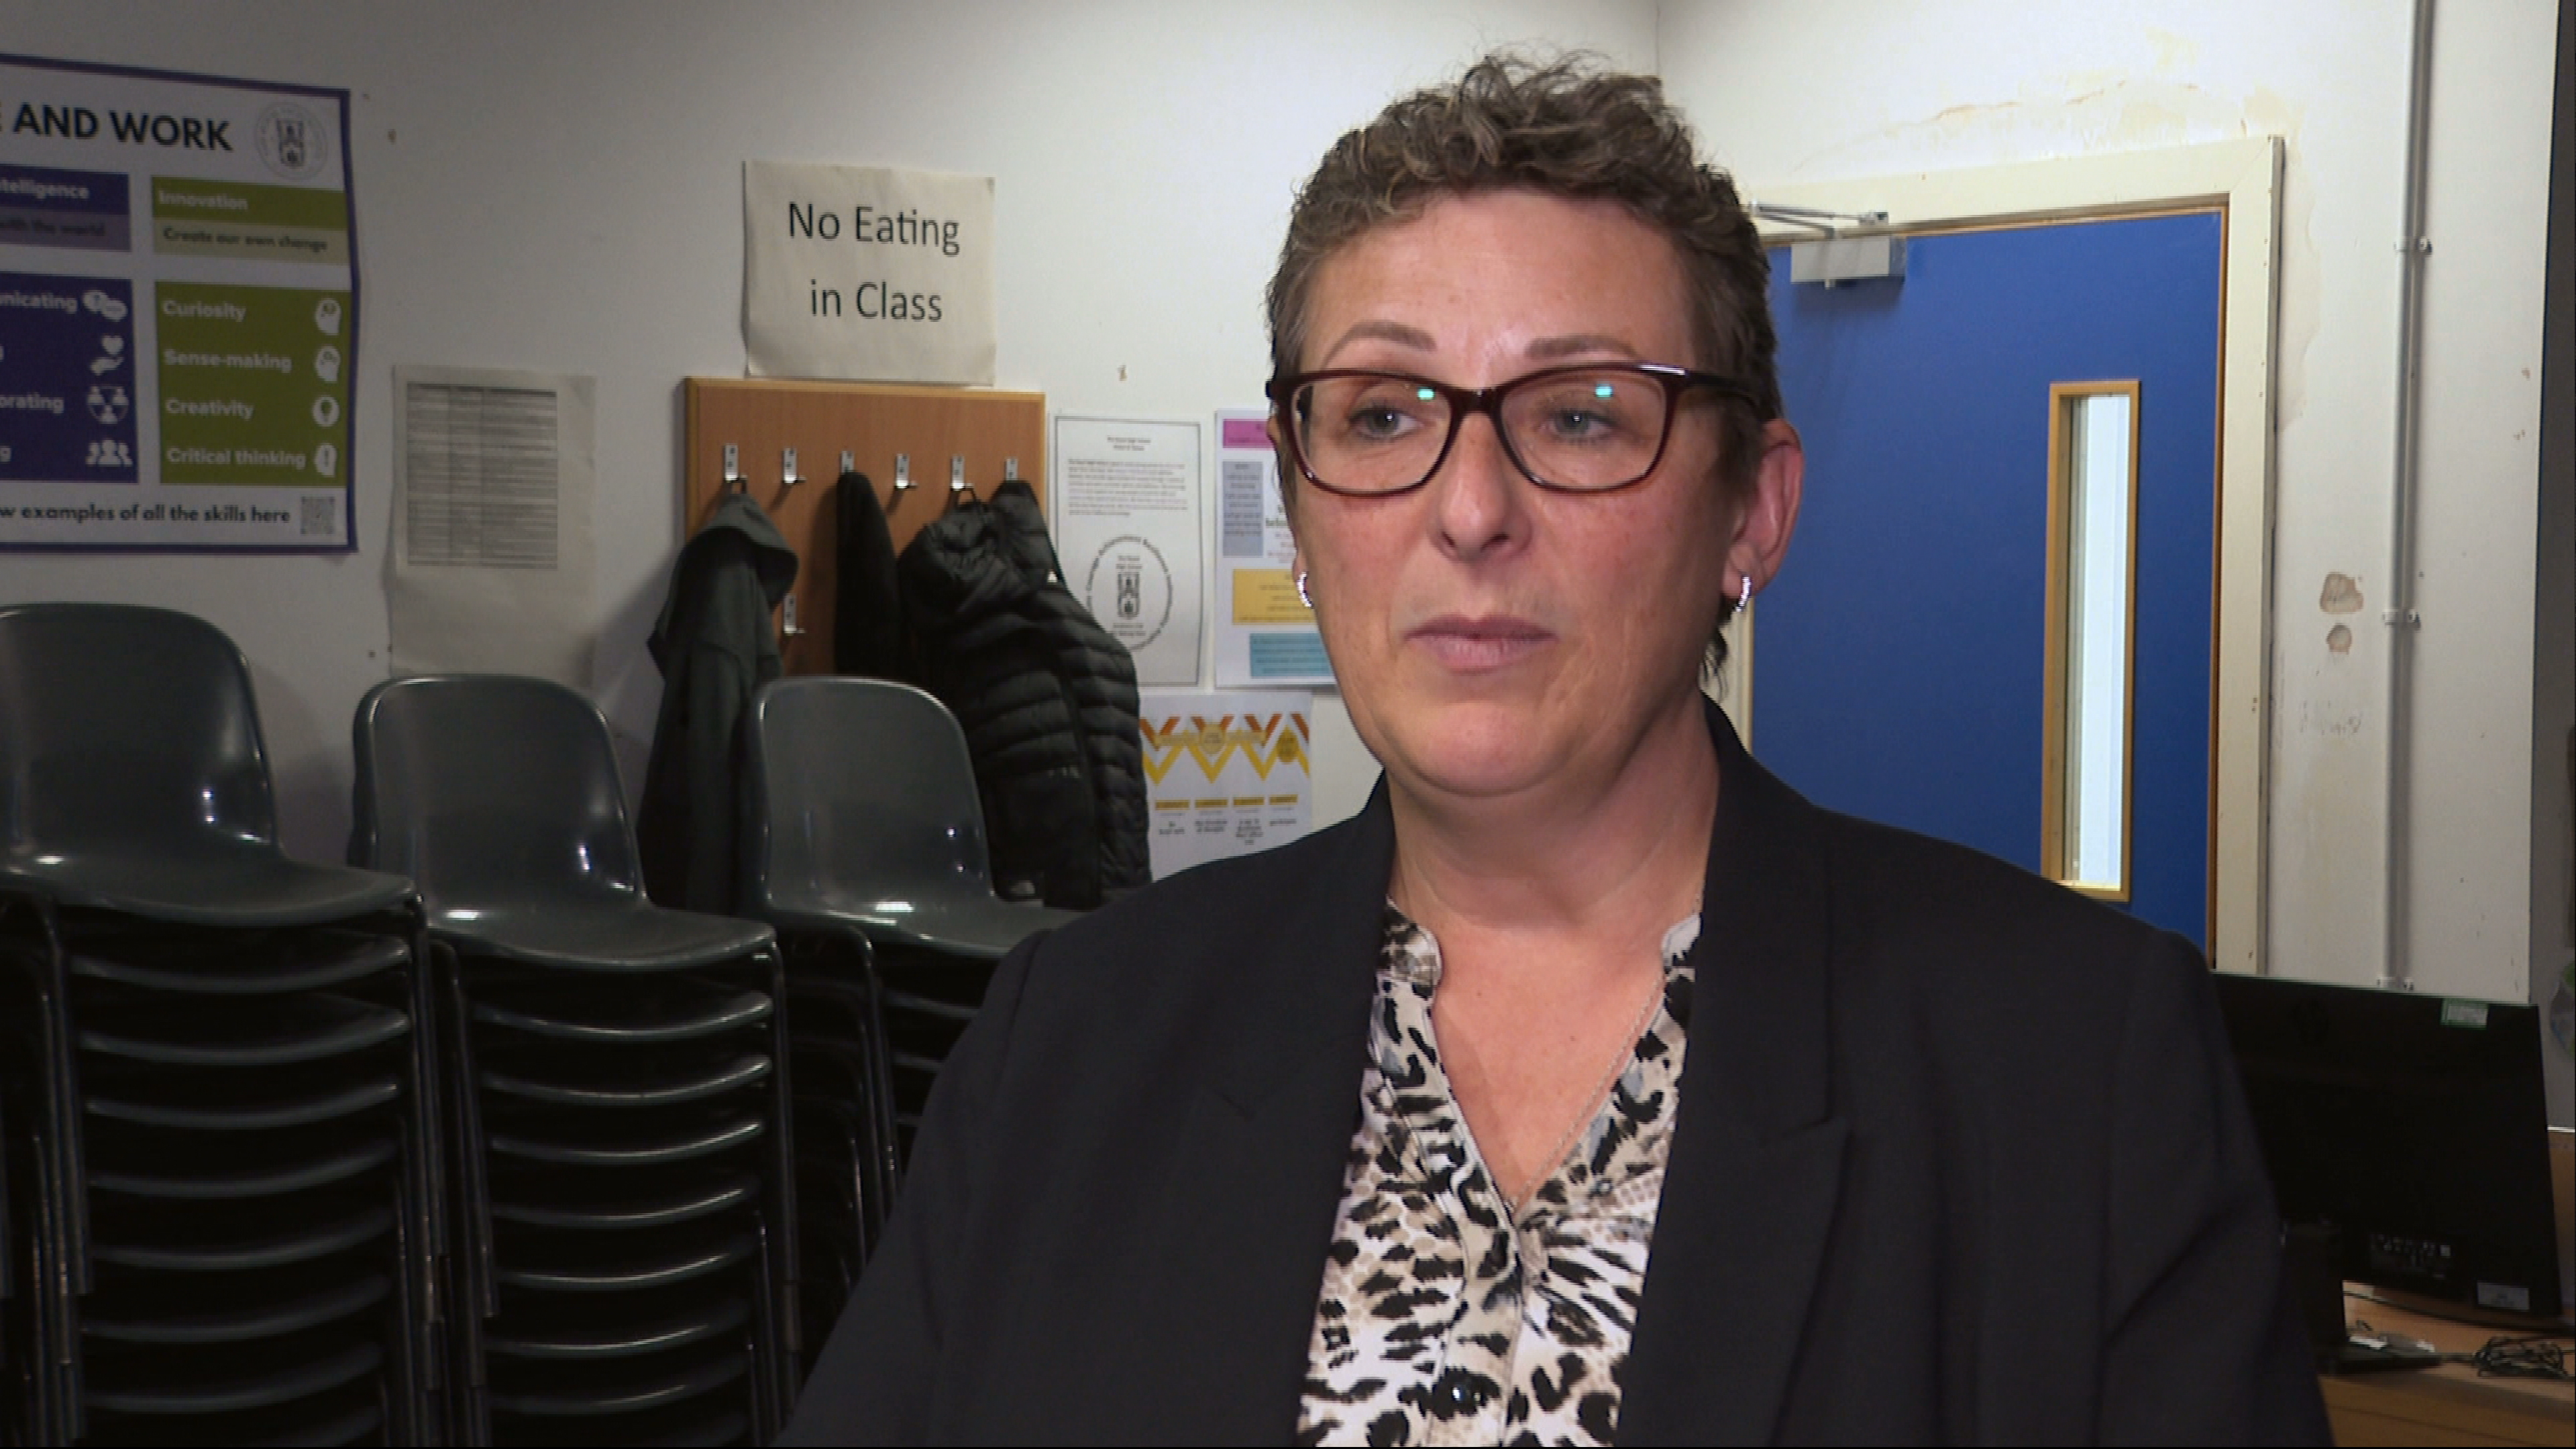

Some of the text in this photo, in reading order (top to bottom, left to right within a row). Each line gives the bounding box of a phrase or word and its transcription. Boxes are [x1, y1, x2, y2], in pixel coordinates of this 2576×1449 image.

[13, 103, 99, 140] AND
[109, 111, 233, 152] WORK
[0, 178, 90, 199] telligence
[158, 190, 249, 211] Innovation
[163, 227, 212, 244] Create
[217, 232, 240, 246] our
[278, 235, 327, 253] change
[789, 202, 960, 256] No Eating
[162, 299, 246, 323] Curiosity
[810, 279, 943, 322] in Class
[164, 349, 292, 374] Sense-making
[165, 398, 254, 421] Creativity
[166, 447, 307, 470] Critical thinking
[21, 502, 115, 524] examples
[120, 502, 141, 521] of
[143, 502, 164, 521] all
[170, 503, 198, 522] the
[204, 504, 246, 523] skills
[252, 506, 290, 523] here
